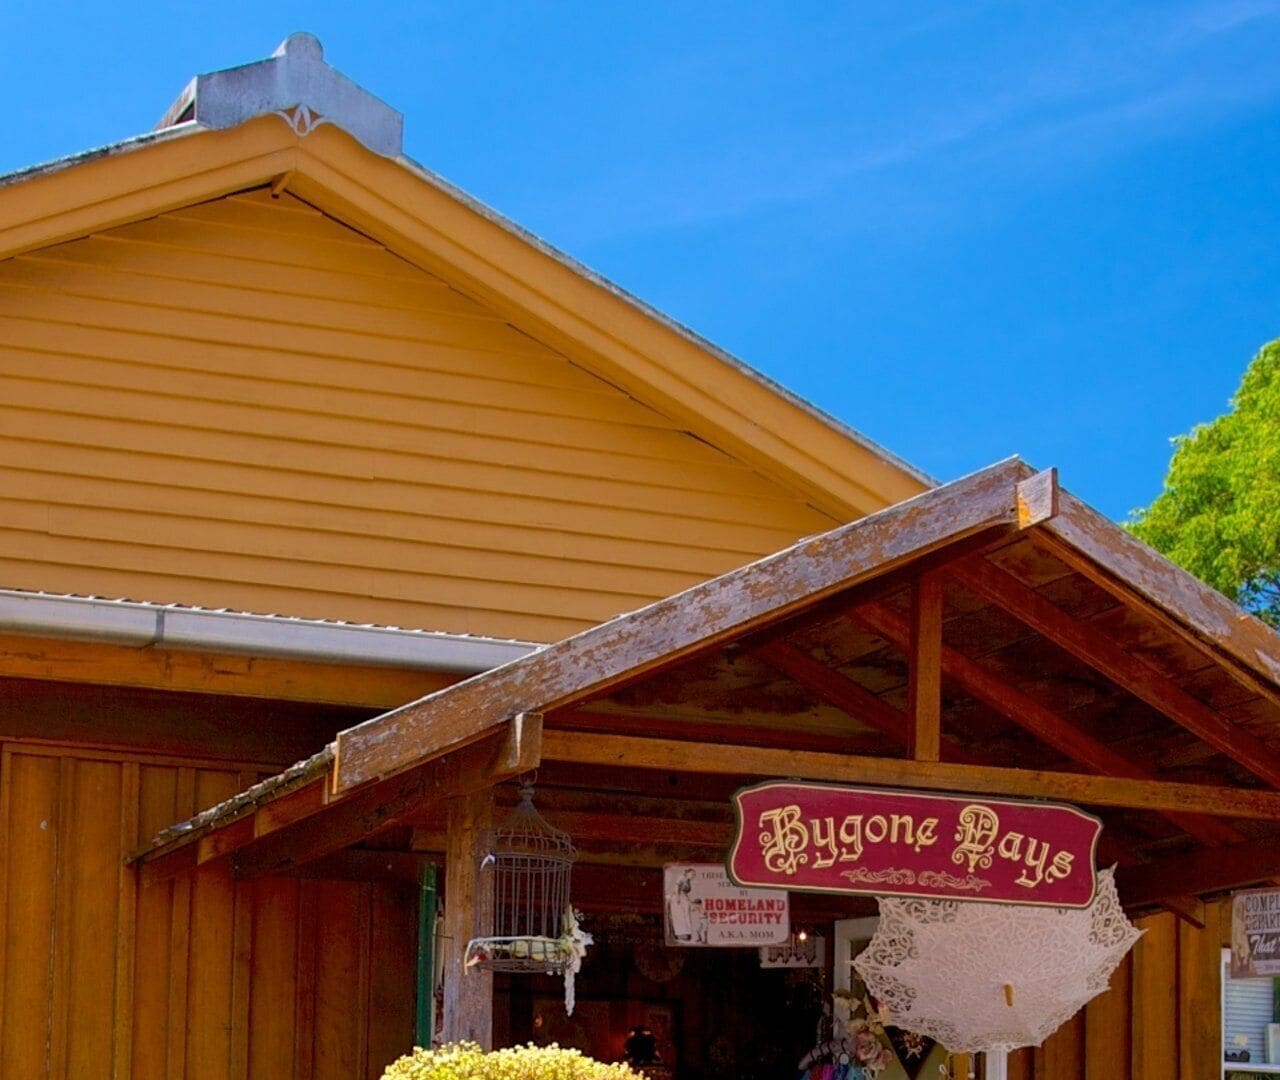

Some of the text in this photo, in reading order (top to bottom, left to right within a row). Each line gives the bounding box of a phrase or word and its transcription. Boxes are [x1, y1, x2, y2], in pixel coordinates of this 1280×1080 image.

[759, 804, 1075, 888] Bygone Days
[705, 898, 786, 911] HOMELAND
[709, 912, 783, 925] SECURITY
[750, 930, 775, 940] MOM
[1250, 934, 1276, 955] That
